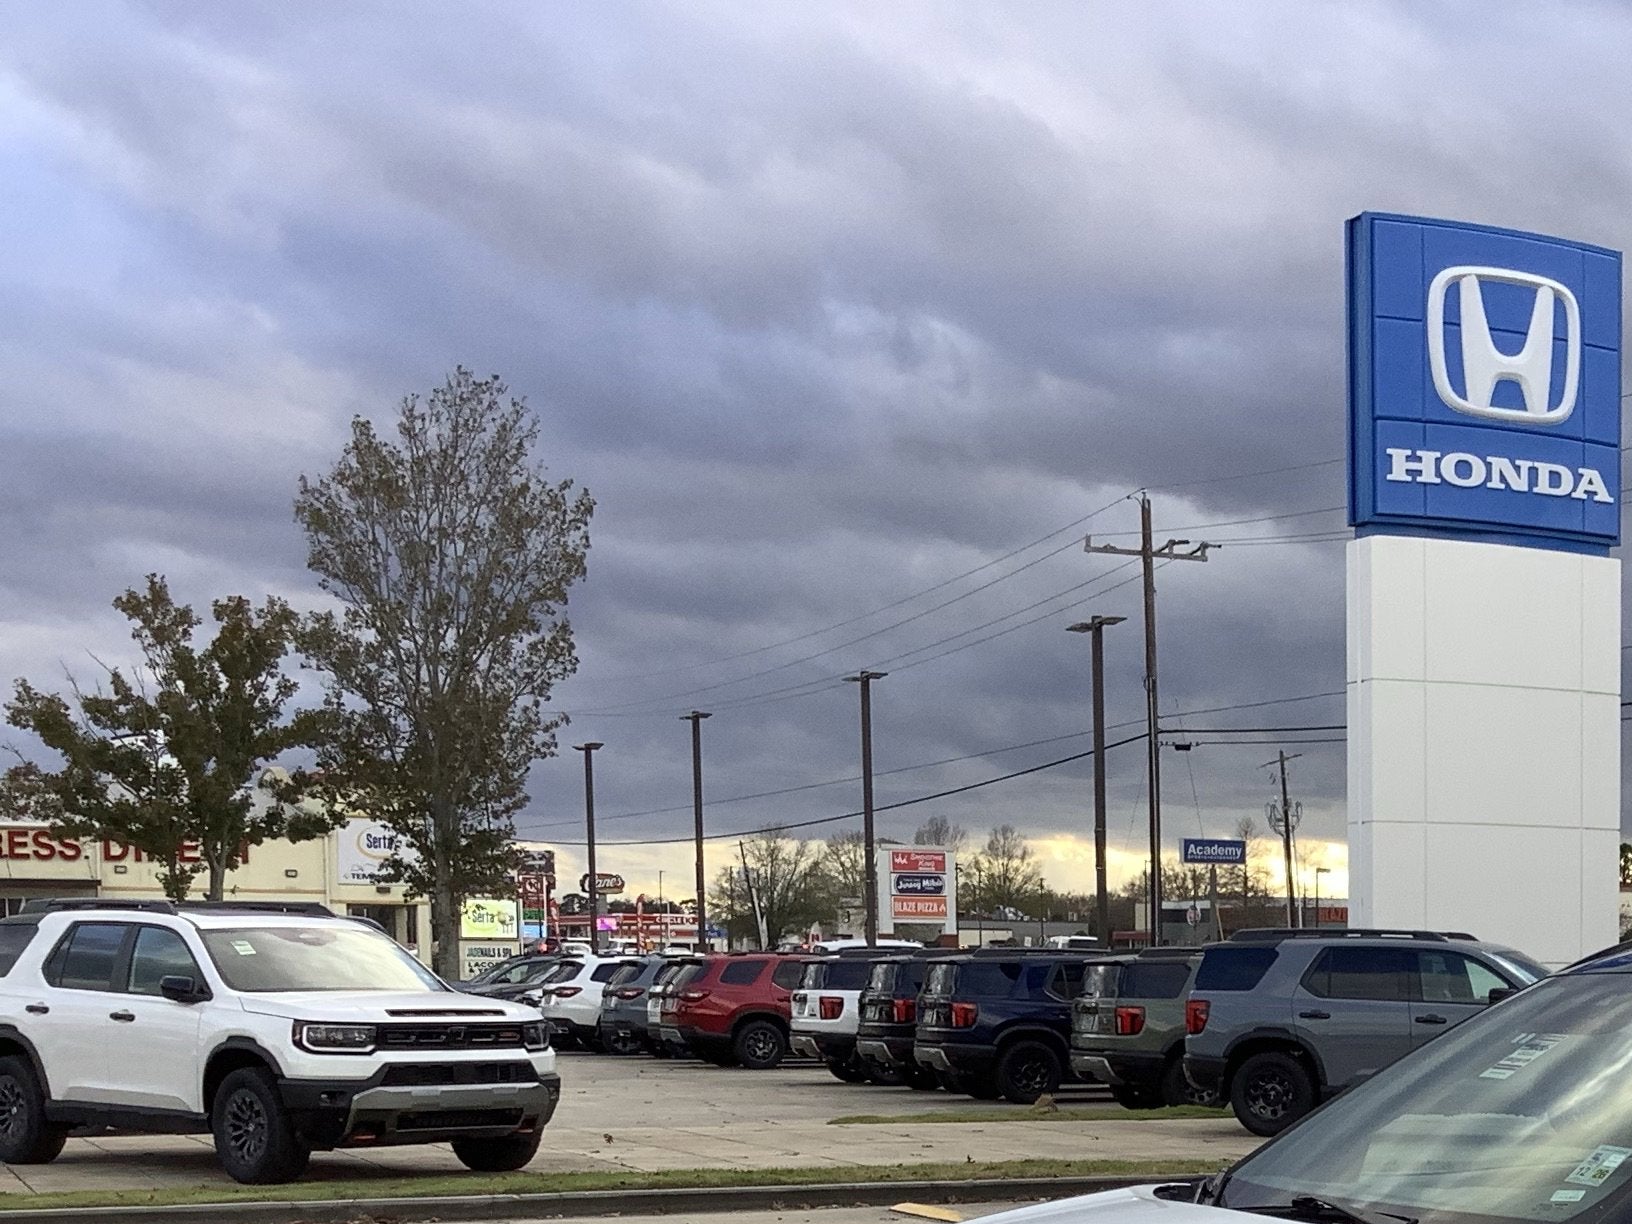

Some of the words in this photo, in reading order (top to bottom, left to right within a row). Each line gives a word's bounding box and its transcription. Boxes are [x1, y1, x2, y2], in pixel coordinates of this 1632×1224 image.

[1386, 448, 1614, 503] HONDA
[1187, 843, 1242, 859] Academy
[917, 902, 938, 913] PIZZA
